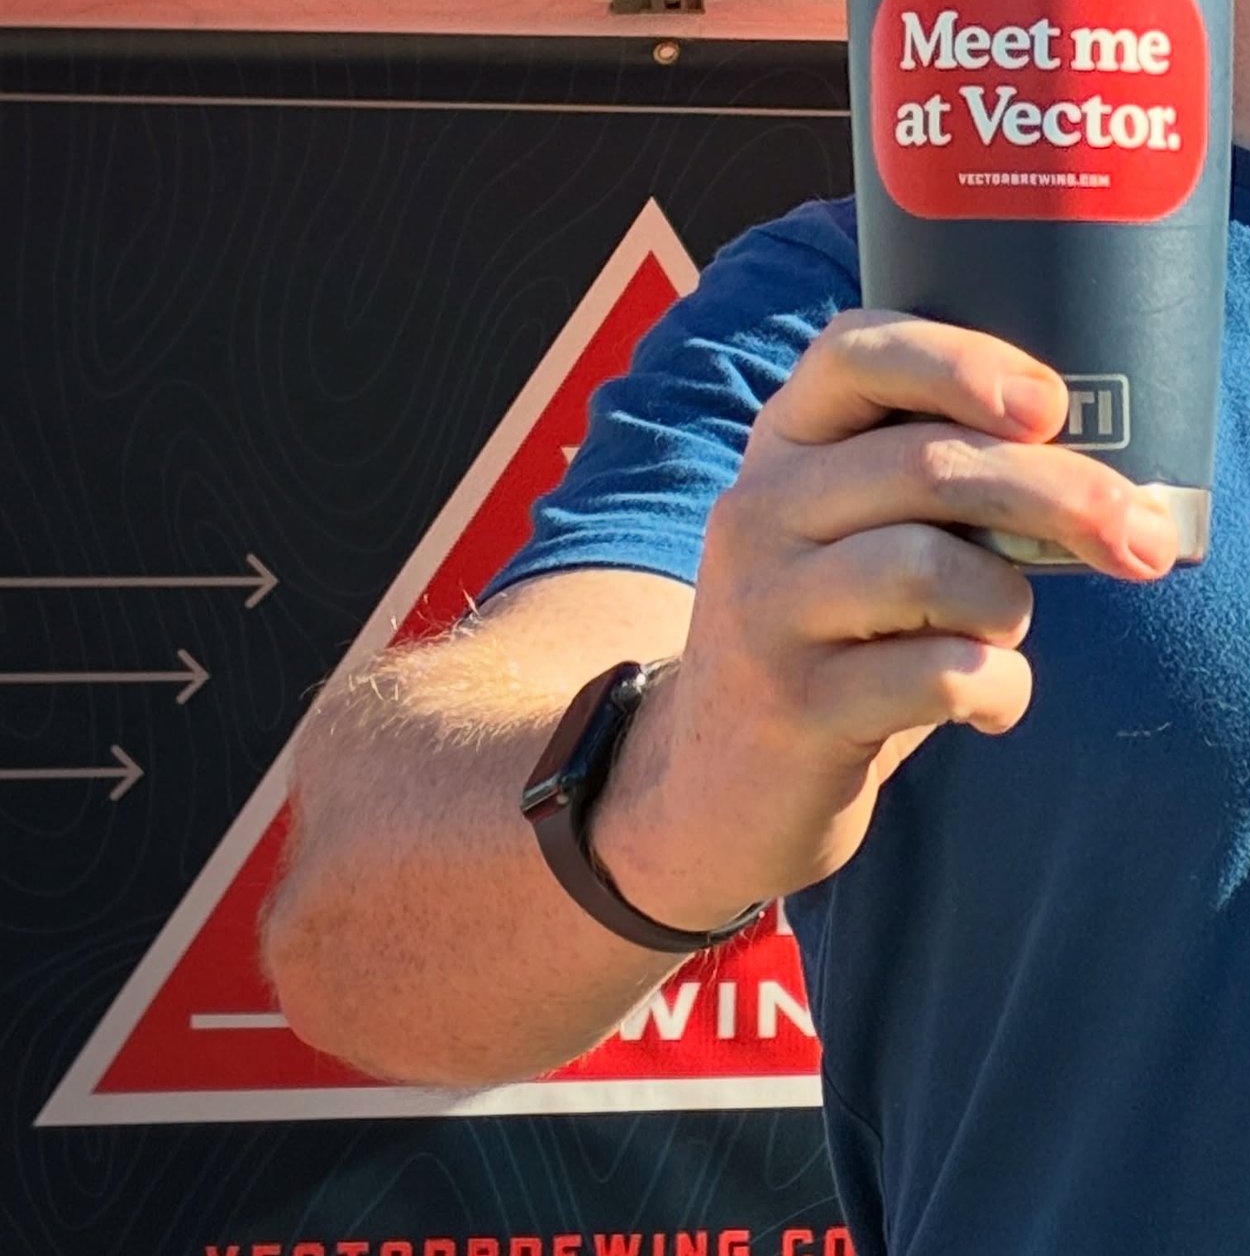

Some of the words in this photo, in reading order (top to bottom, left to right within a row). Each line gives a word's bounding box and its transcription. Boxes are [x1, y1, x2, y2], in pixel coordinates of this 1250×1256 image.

[901, 10, 1061, 71] Meet
[1070, 26, 1171, 75] me
[895, 93, 953, 147] at
[960, 84, 1181, 151] Vector.
[958, 172, 1111, 188] VECTORBREWING.COM
